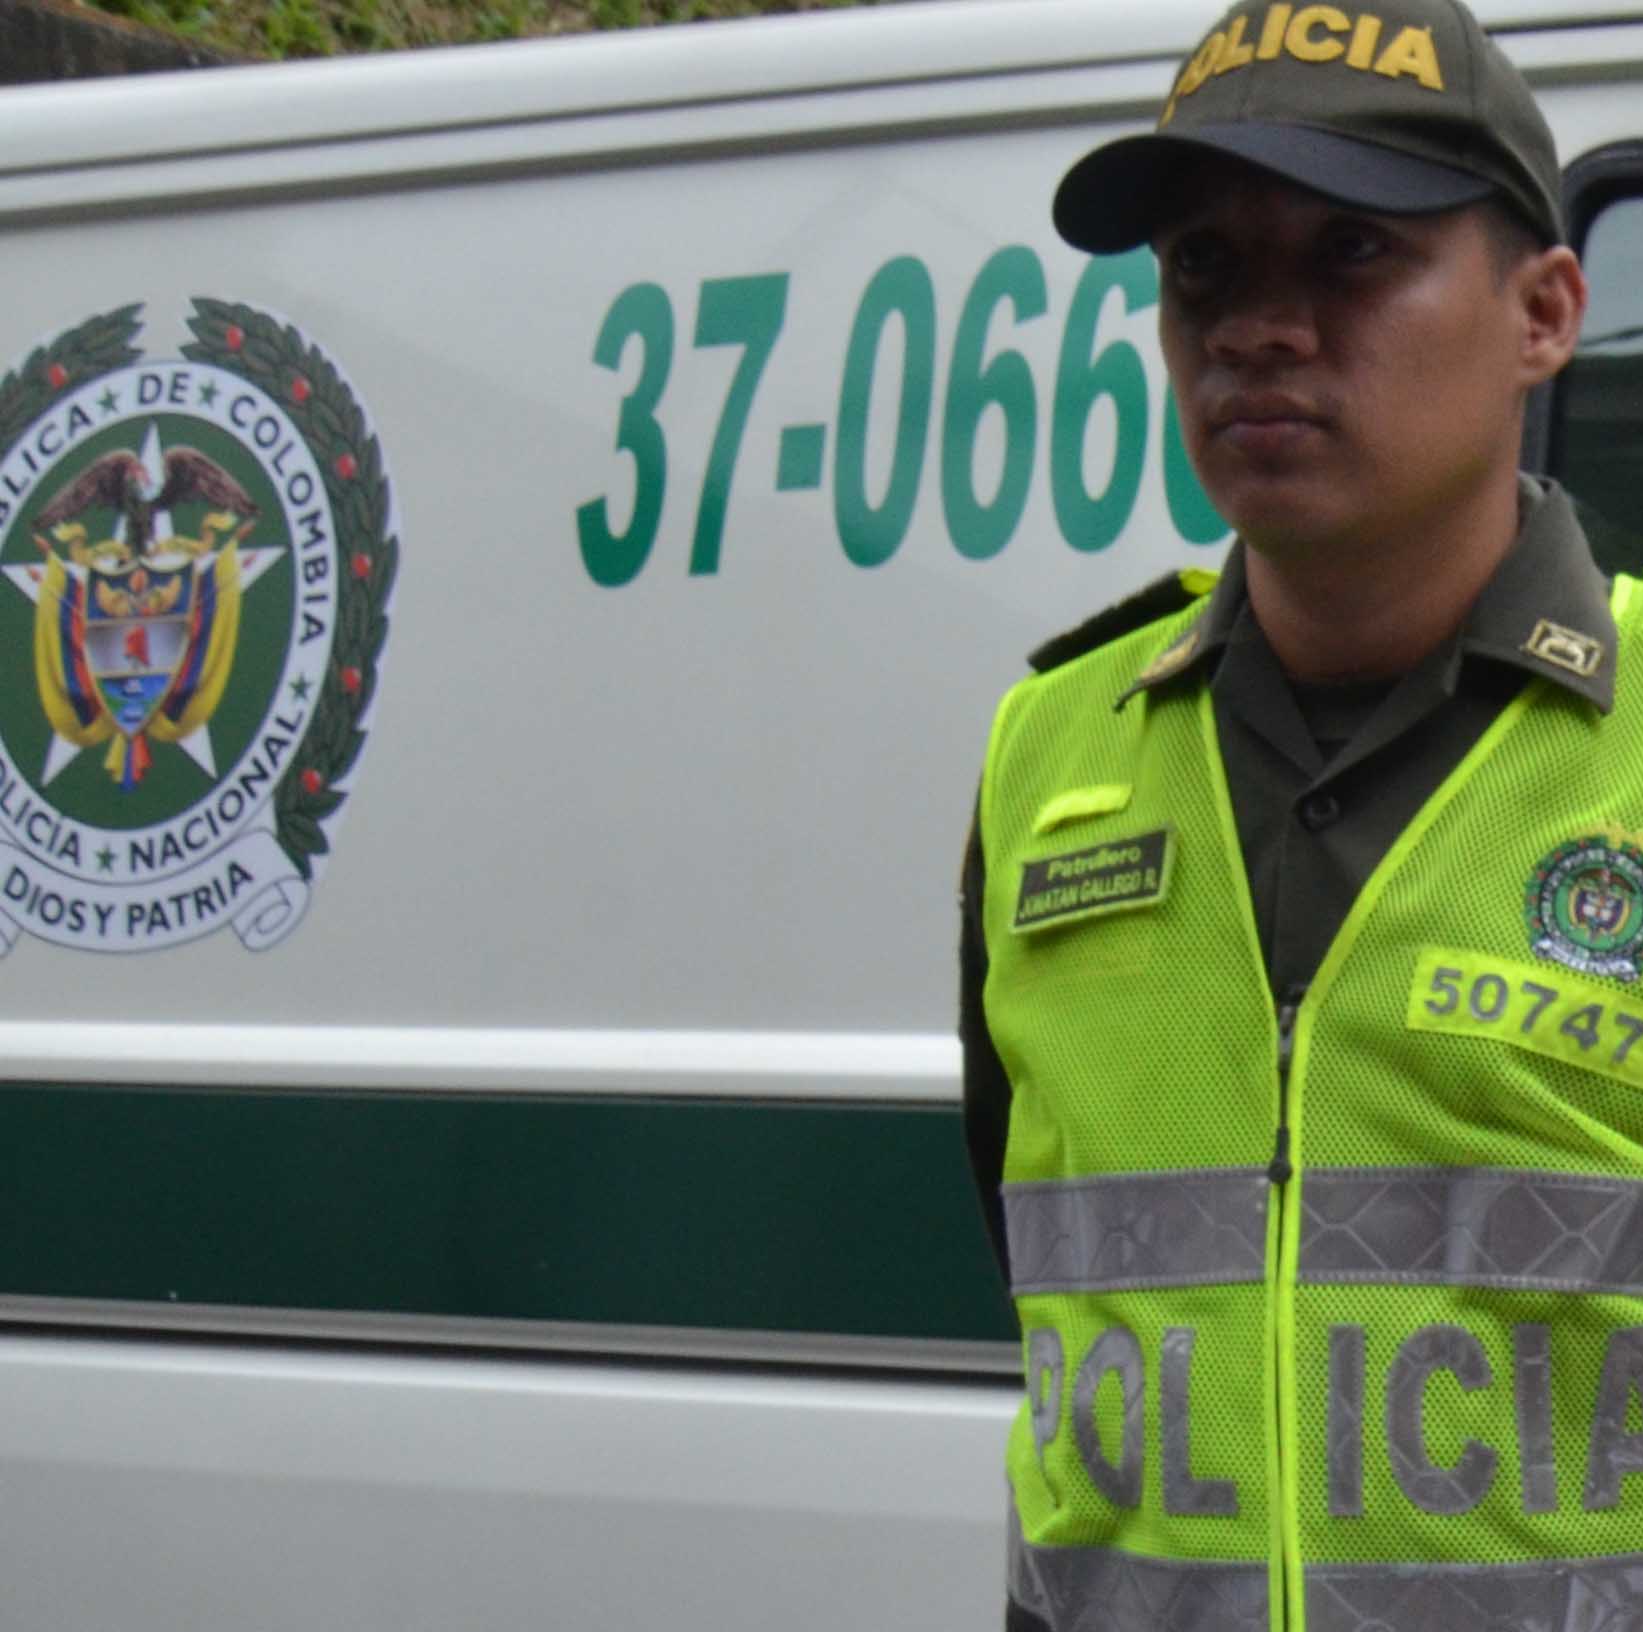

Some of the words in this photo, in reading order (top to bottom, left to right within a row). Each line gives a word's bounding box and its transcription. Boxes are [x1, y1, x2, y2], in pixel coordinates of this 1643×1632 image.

[137, 371, 191, 407] DE
[228, 393, 331, 645] COLOMBIA
[0, 757, 82, 867] LICIA
[129, 710, 305, 874] NACIONAL
[126, 860, 254, 938] PATRIA
